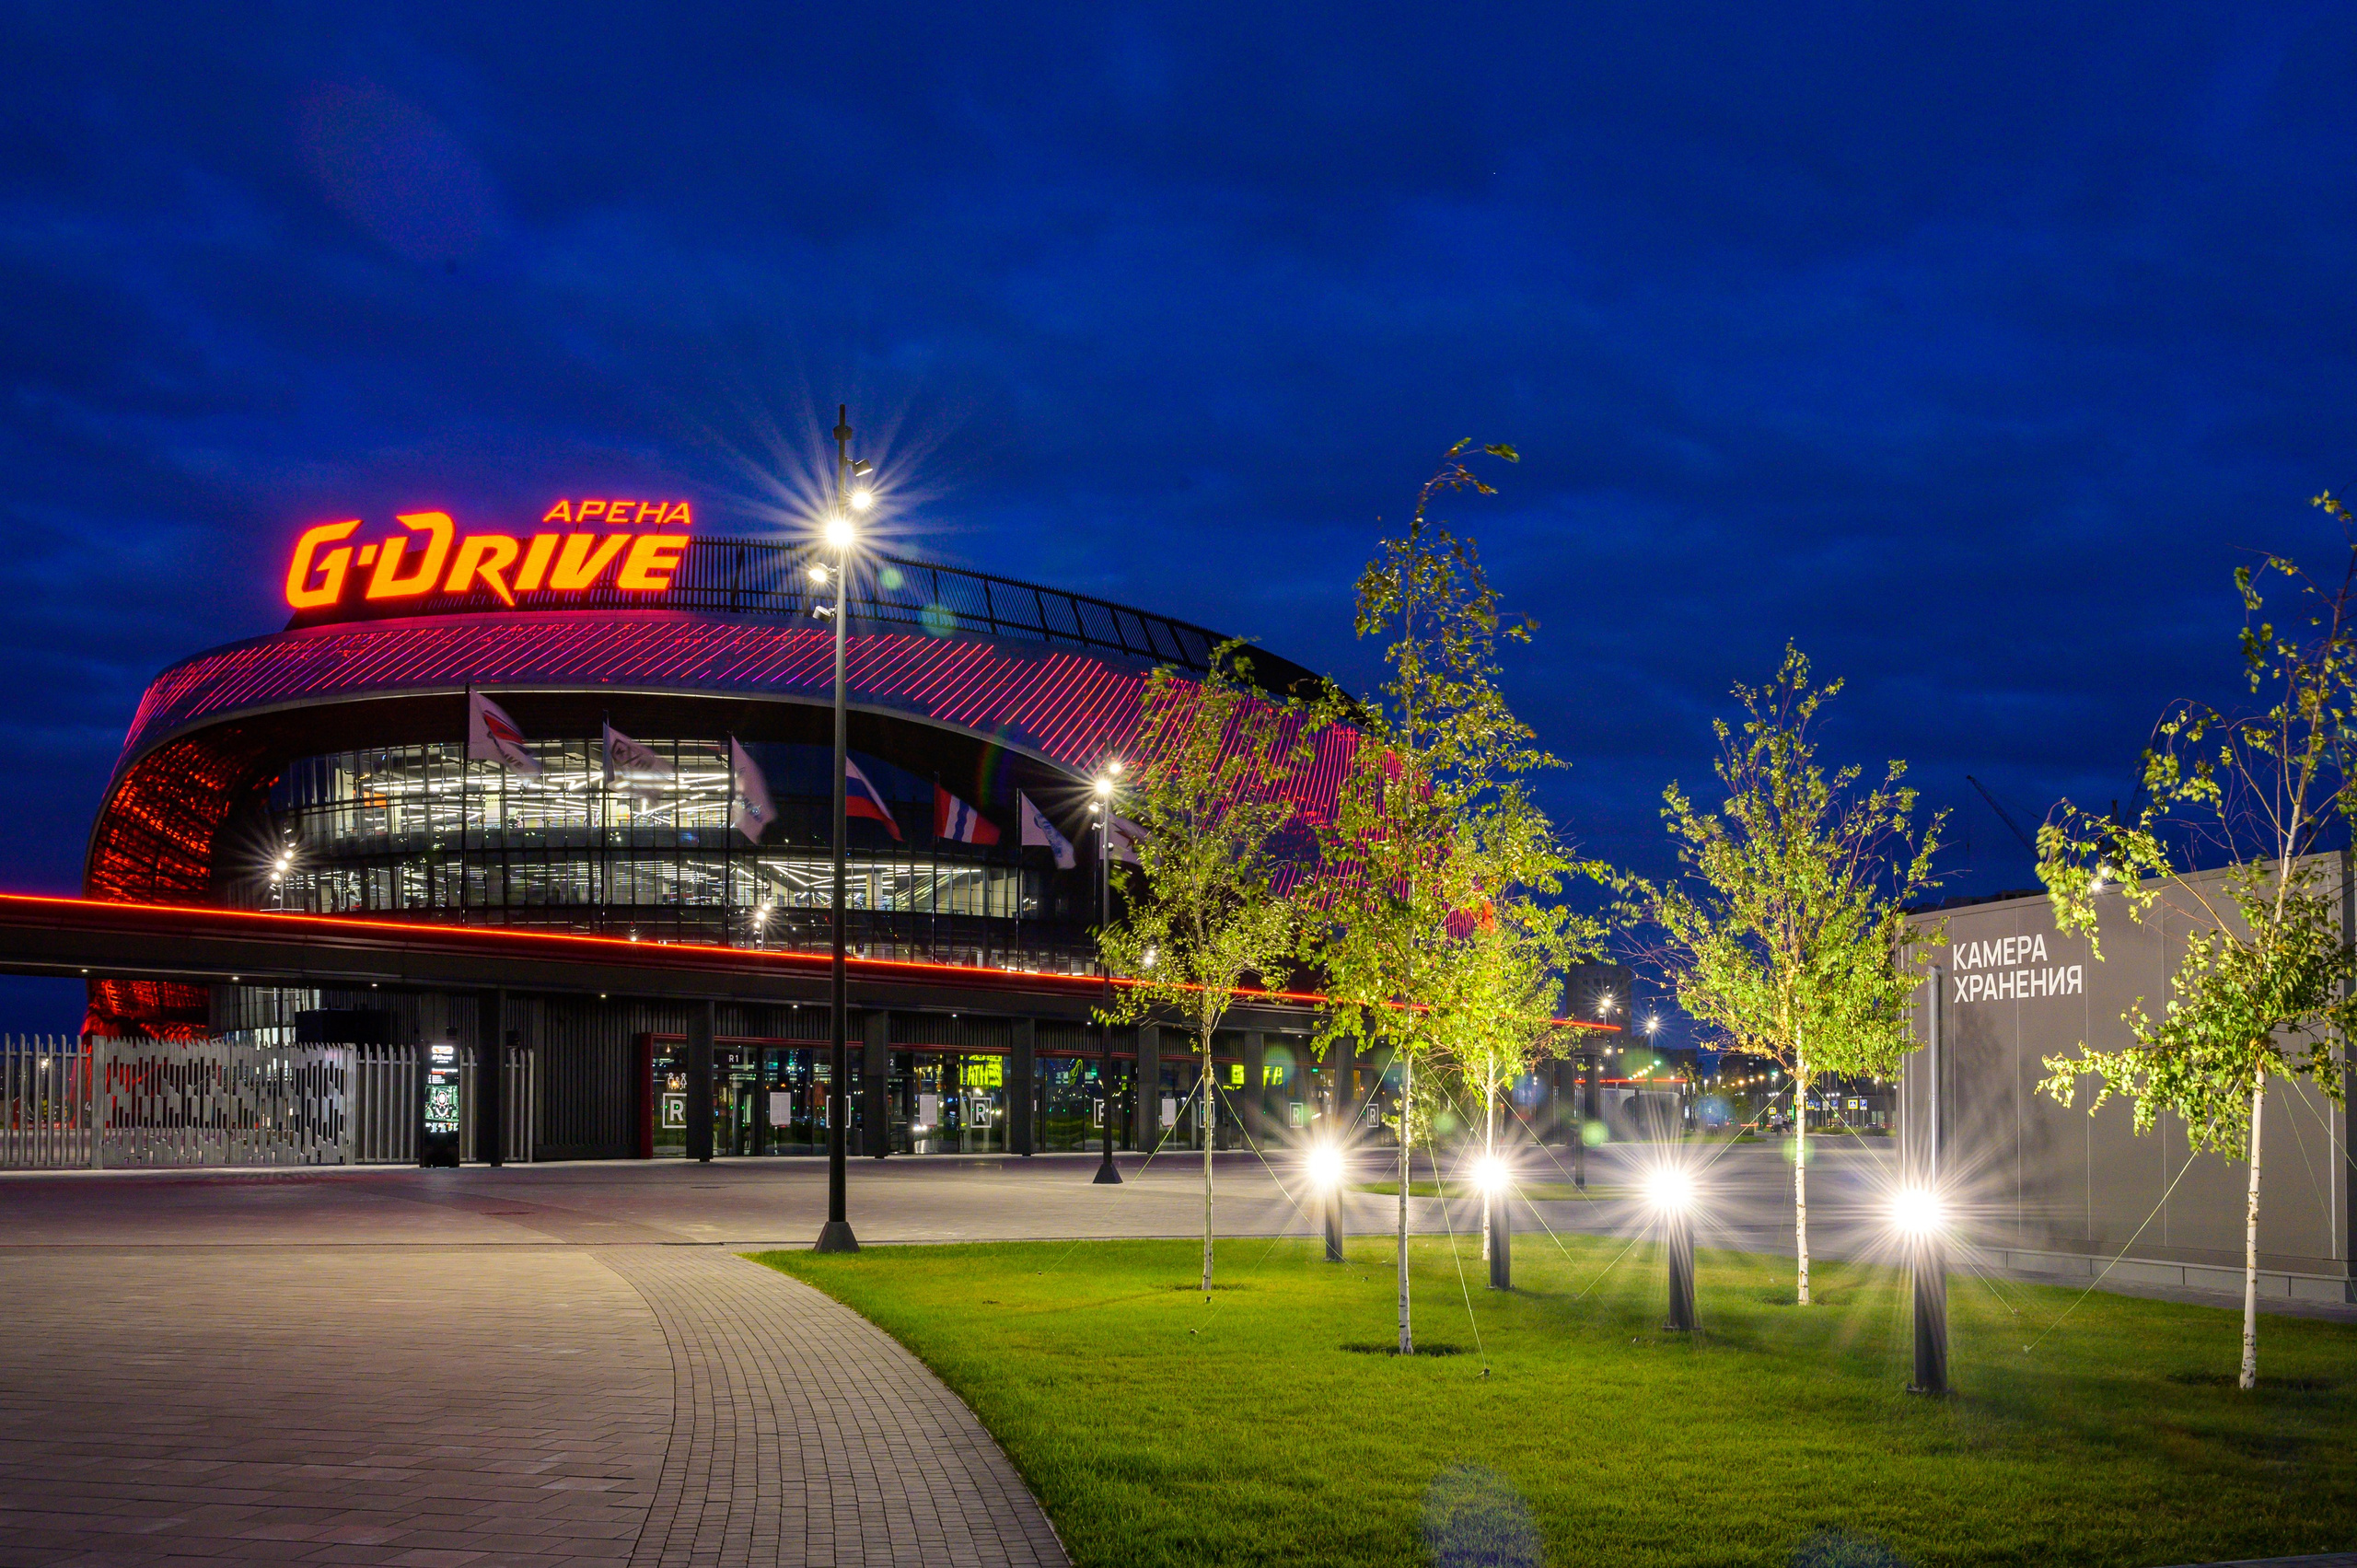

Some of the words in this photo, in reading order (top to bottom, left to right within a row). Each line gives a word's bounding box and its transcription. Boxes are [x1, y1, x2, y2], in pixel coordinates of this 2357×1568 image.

[543, 500, 691, 523] АРЕНА
[1953, 934, 2048, 970] КАМЕРА
[1954, 965, 2083, 1004] ХРАНЕНИЯ
[728, 1054, 739, 1063] R1
[669, 1099, 684, 1121] R
[975, 1103, 986, 1122] R
[1293, 1107, 1300, 1123] R
[1369, 1108, 1376, 1123] R
